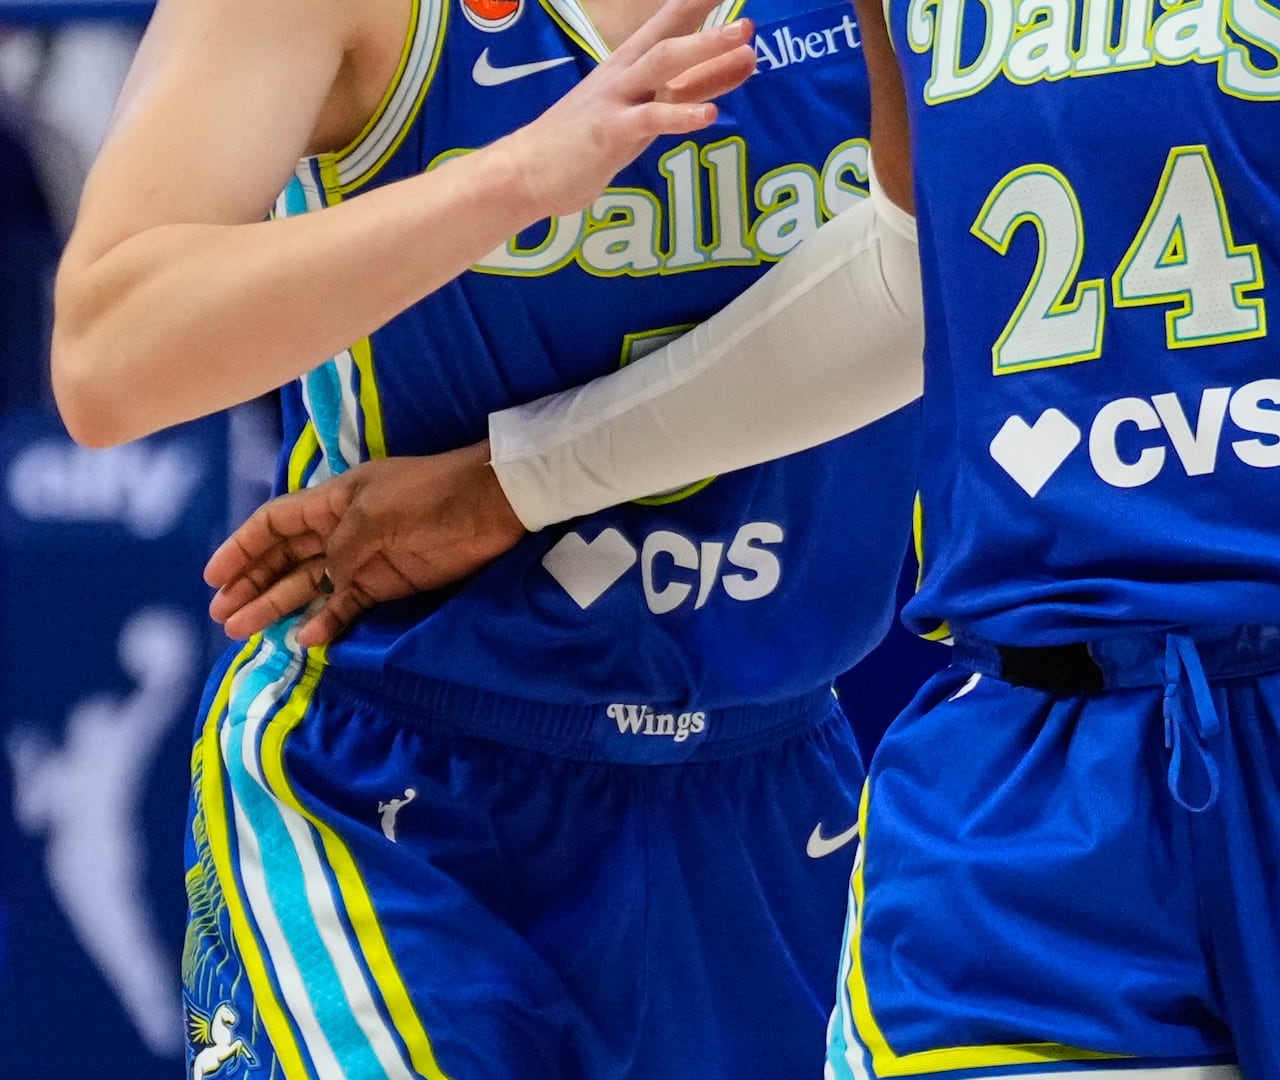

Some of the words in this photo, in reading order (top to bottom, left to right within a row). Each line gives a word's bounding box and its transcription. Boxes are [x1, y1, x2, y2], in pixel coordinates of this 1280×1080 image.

[752, 14, 861, 75] Albert
[970, 144, 1267, 376] 24
[606, 702, 706, 743] Wings
